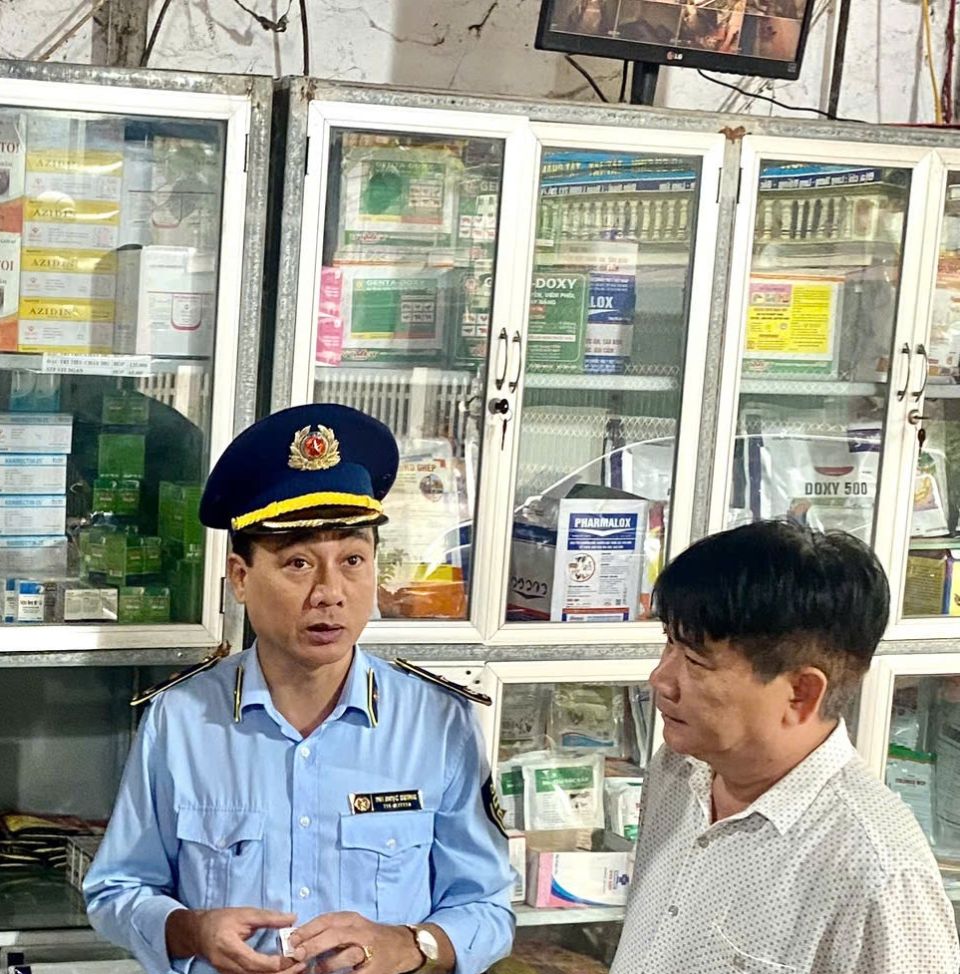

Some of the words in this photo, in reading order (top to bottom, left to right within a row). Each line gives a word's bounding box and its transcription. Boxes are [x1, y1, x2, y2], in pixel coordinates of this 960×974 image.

[805, 482, 840, 495] DOXY
[844, 482, 868, 495] 500
[574, 517, 631, 528] PHARMALOX
